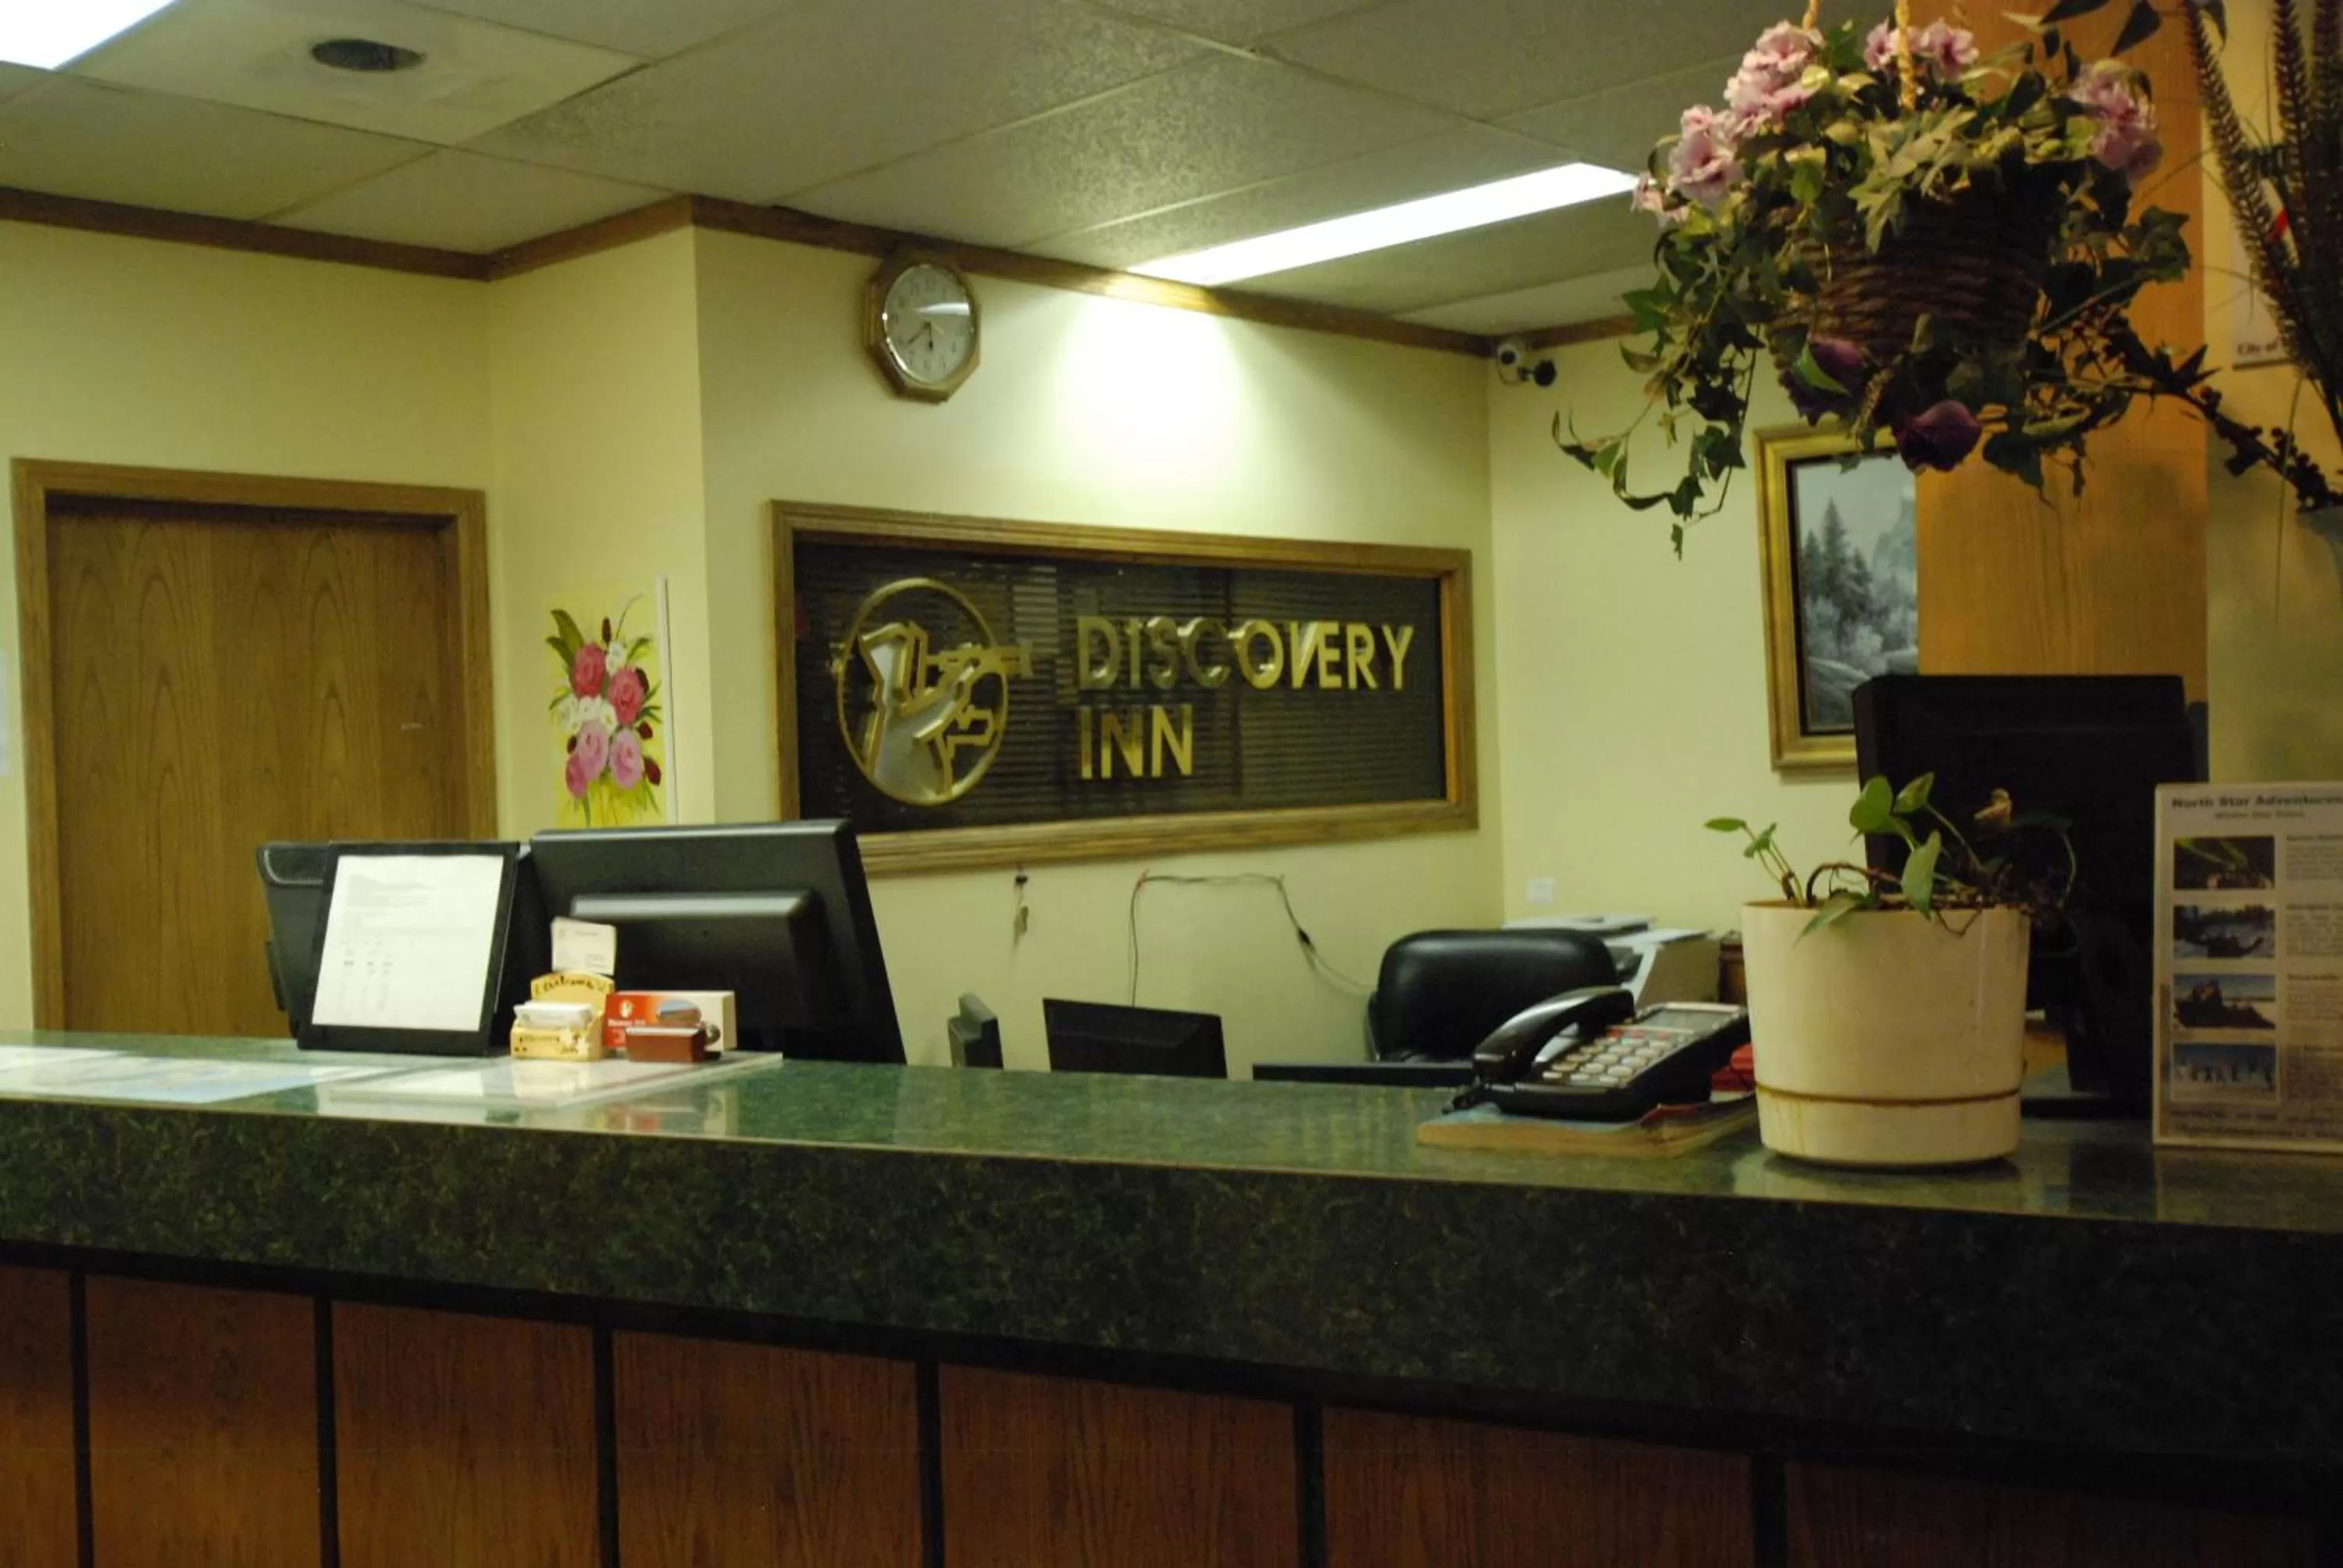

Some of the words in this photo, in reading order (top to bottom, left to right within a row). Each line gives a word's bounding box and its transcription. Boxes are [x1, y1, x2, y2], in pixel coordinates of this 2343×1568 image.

[1078, 615, 1414, 691] DISCOVERY
[1078, 704, 1194, 779] INN
[2171, 796, 2214, 808] North
[2219, 795, 2249, 807] Star
